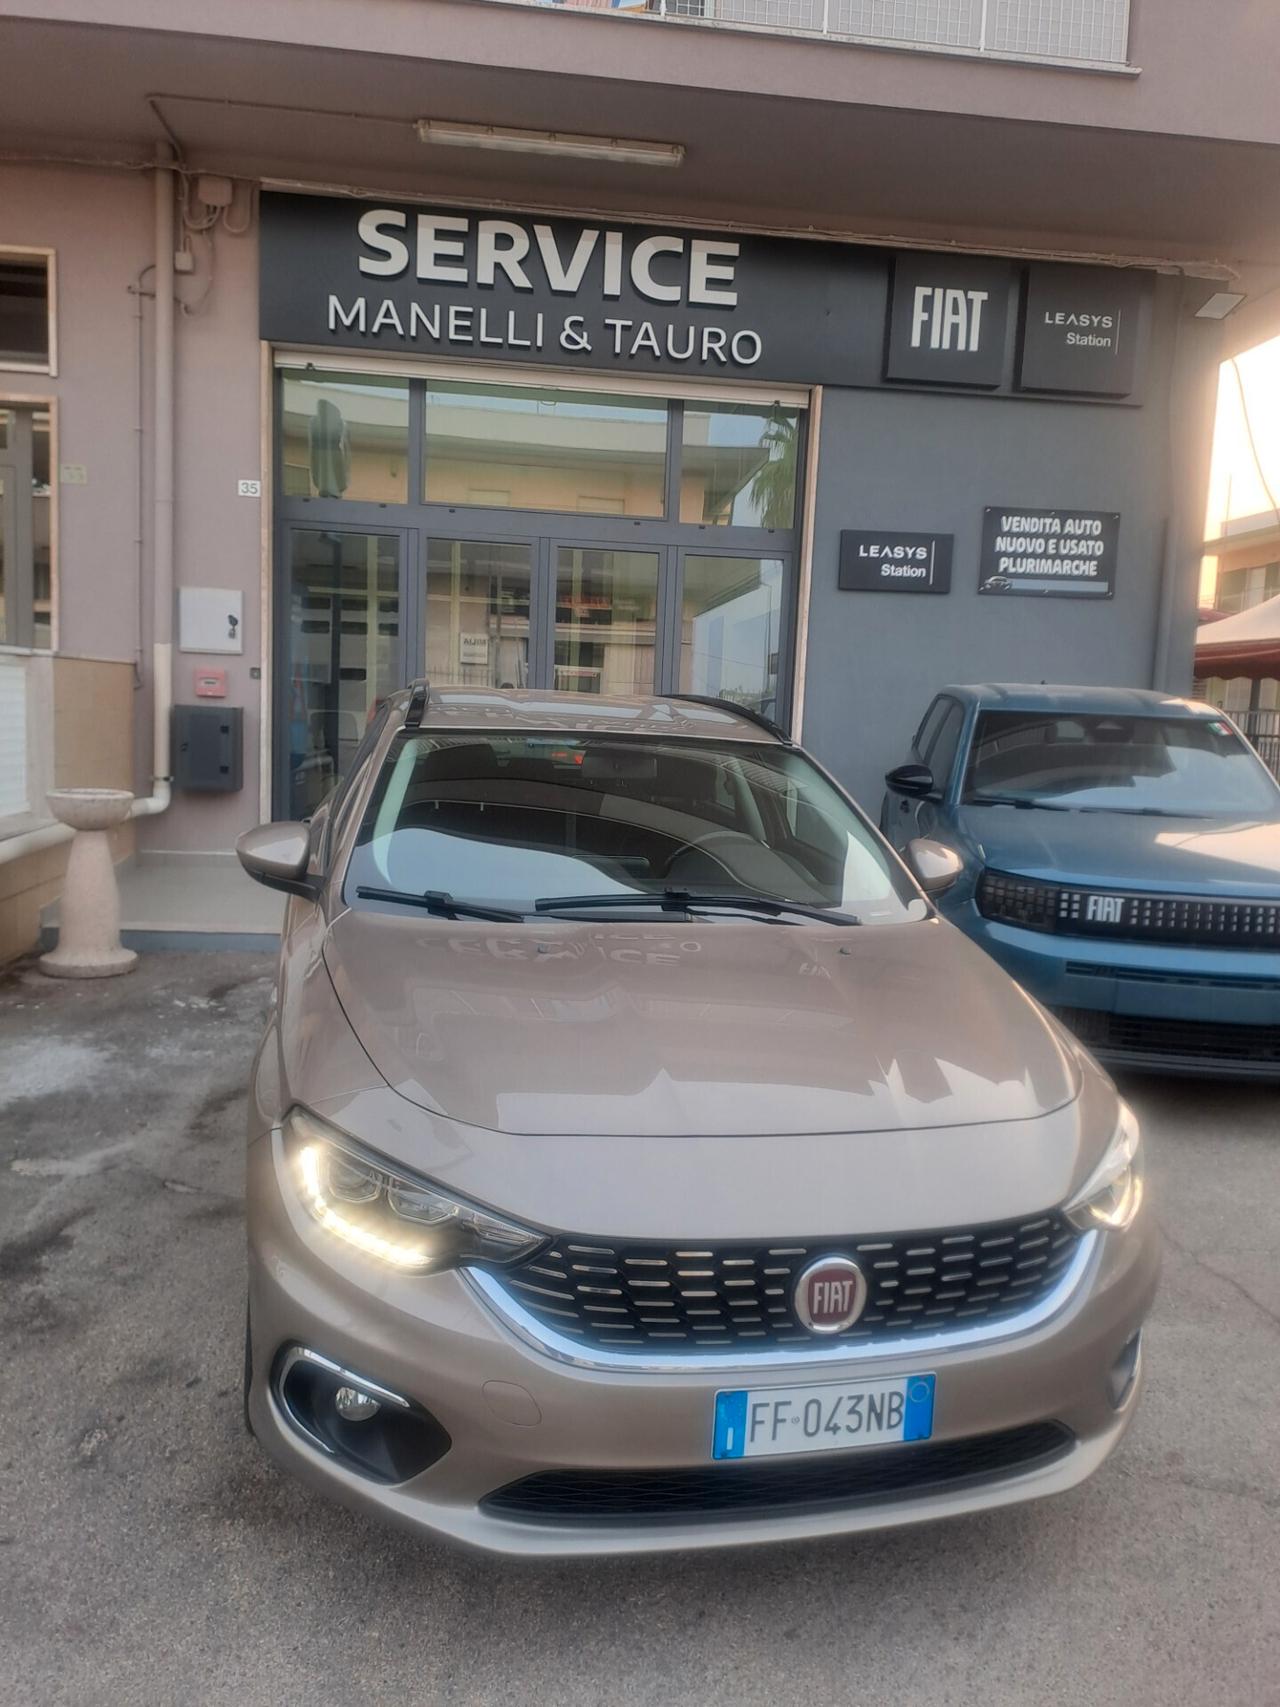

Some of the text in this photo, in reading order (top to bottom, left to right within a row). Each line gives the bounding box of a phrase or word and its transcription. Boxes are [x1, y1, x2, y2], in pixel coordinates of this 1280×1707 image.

[356, 208, 741, 307] SERVICE
[910, 285, 989, 352] FIAT
[1044, 311, 1114, 329] LEASYS
[327, 294, 763, 366] MANELLI & TAURO
[1066, 331, 1112, 348] Station
[241, 482, 258, 494] 35
[1001, 516, 1103, 536] VENDITA AUTO
[858, 544, 928, 561] LEASYS
[994, 536, 1105, 556] NUOVO E USATO
[880, 563, 927, 578] Station
[998, 556, 1098, 577] PLURIMARCHE
[1086, 895, 1126, 923] FIAT
[812, 1280, 854, 1315] FIAT
